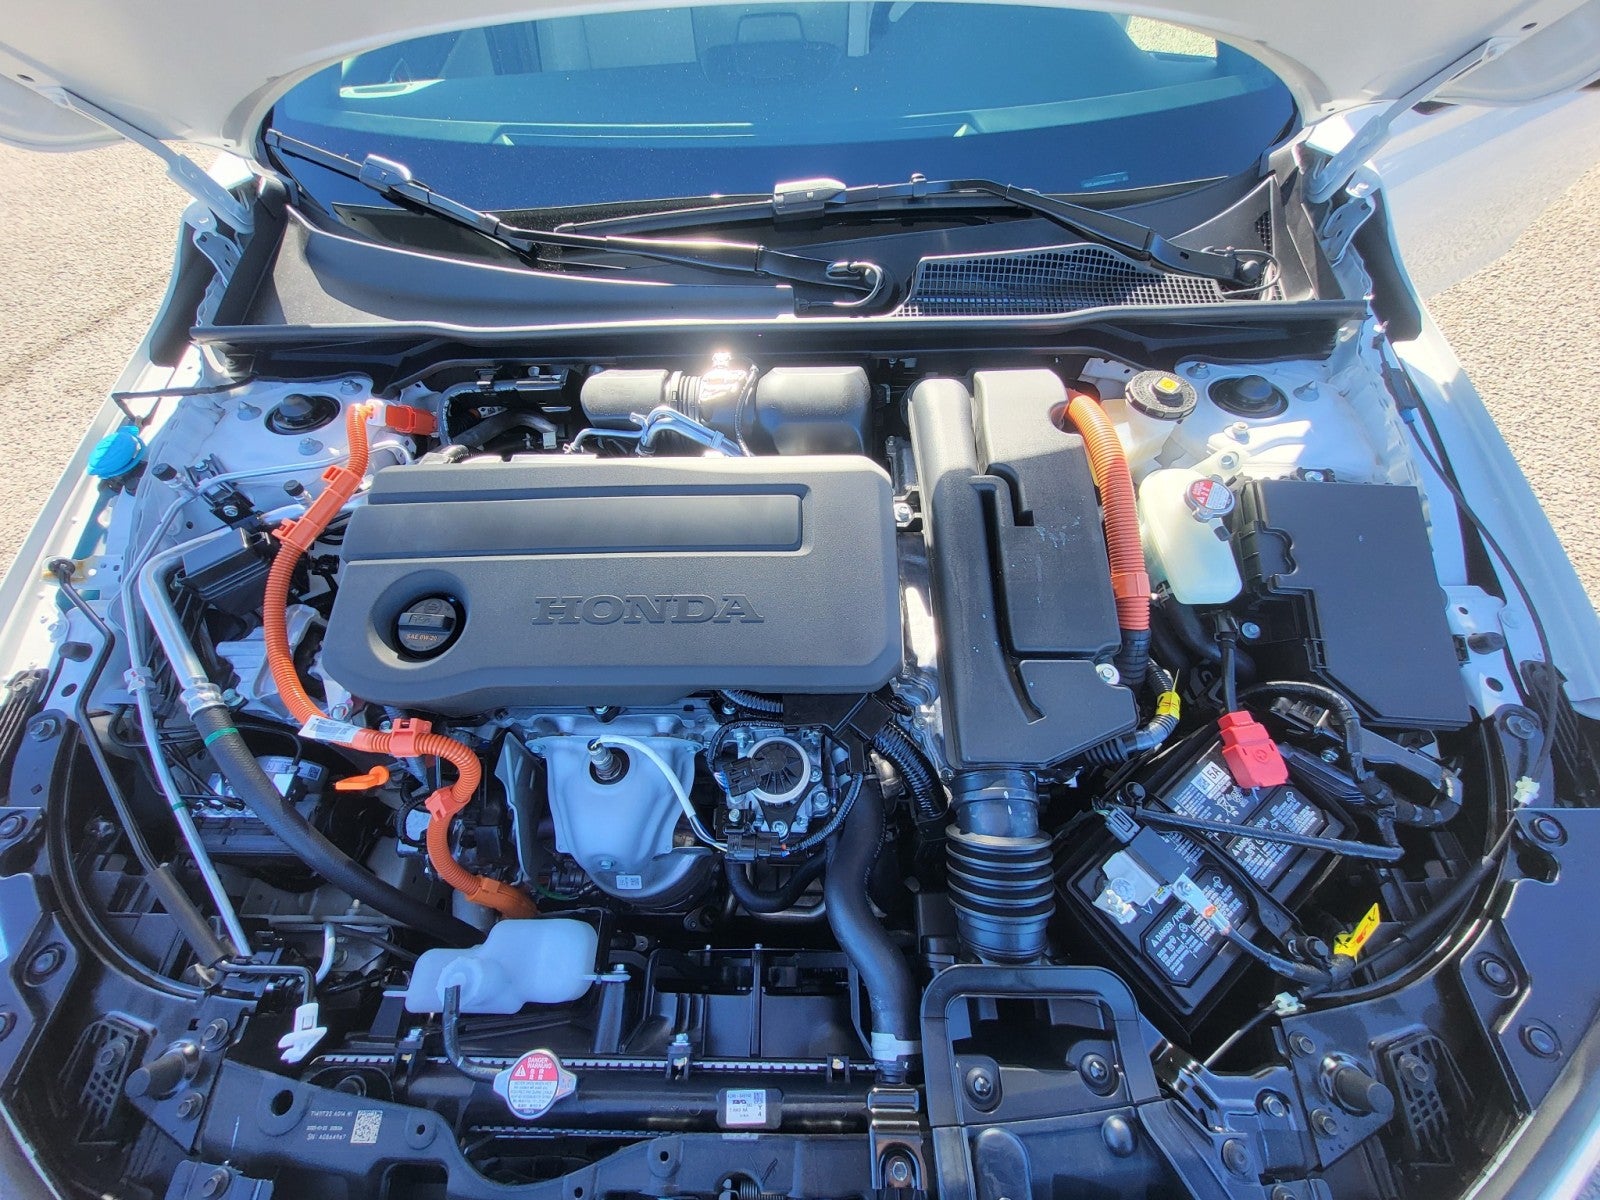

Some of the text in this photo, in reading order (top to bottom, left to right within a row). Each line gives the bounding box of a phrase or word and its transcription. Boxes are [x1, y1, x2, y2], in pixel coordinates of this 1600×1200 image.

[531, 594, 765, 626] HONDA
[406, 633, 438, 641] SAE 0W-20
[1206, 765, 1222, 780] 5A
